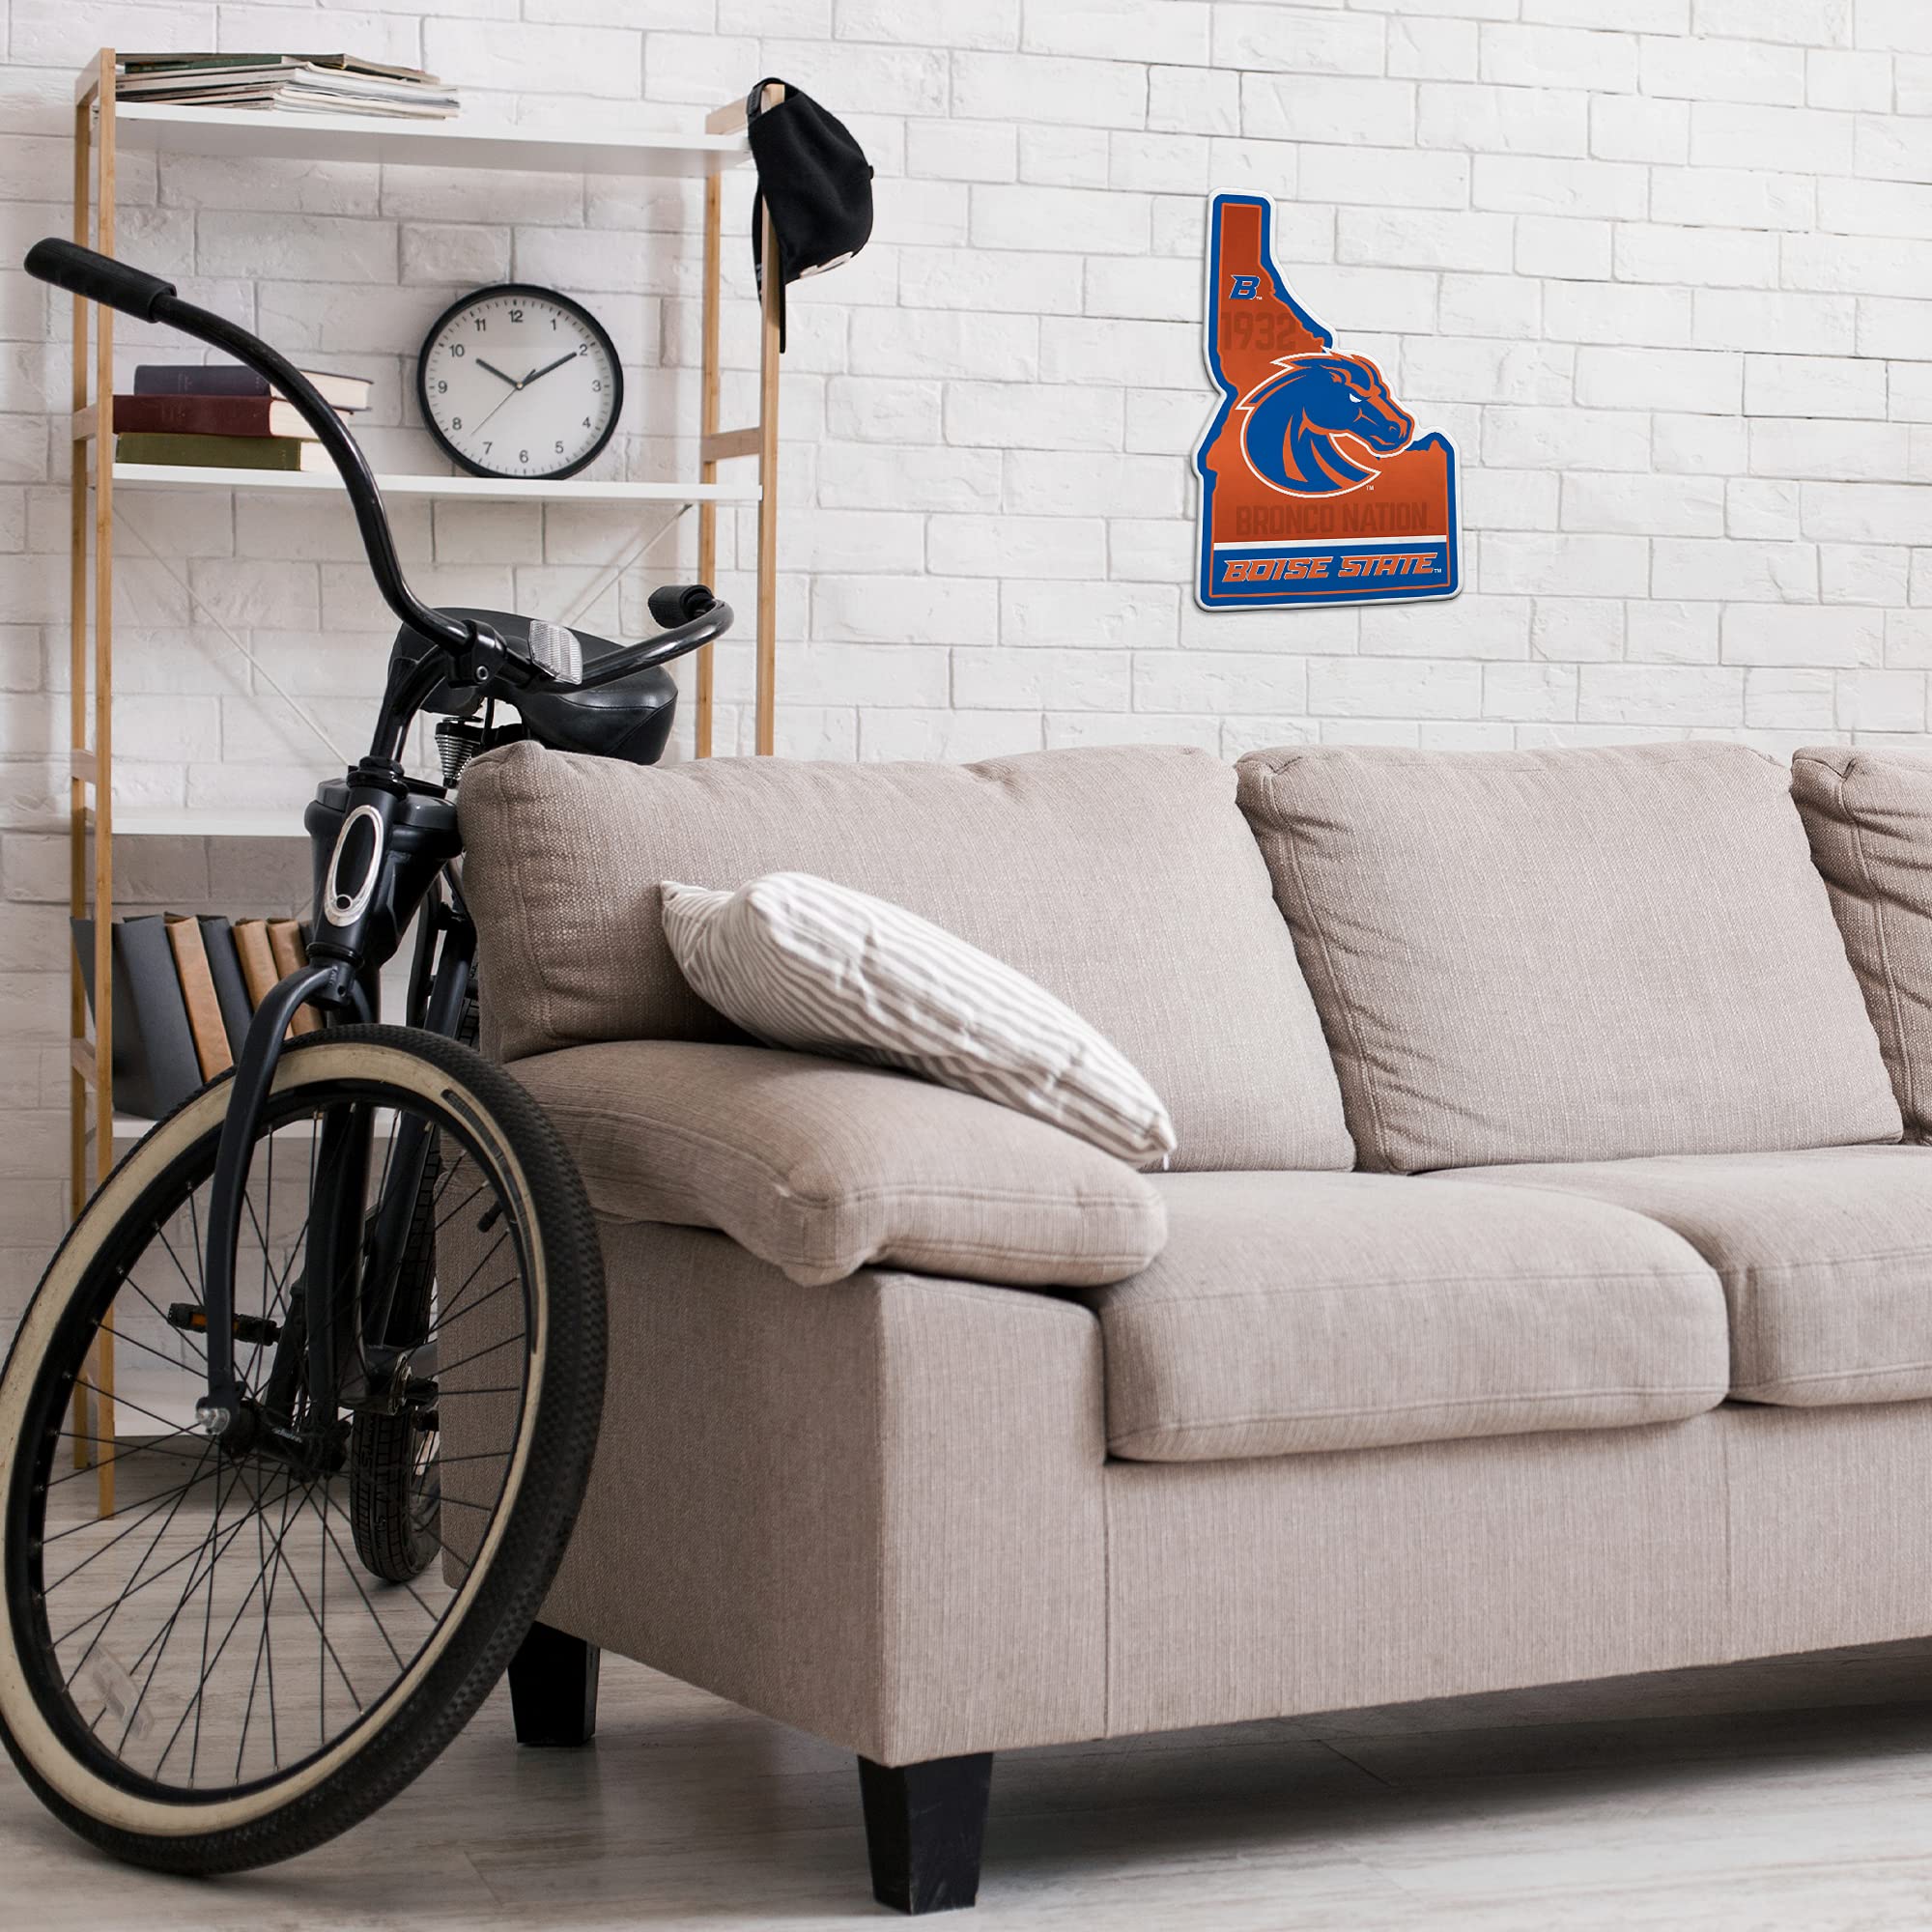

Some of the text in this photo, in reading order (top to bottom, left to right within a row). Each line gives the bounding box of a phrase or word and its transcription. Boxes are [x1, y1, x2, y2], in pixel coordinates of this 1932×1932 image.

[1229, 274, 1261, 300] B
[508, 309, 524, 324] 12
[474, 318, 487, 331] 11
[550, 318, 557, 330] 1
[1221, 311, 1296, 351] 1932
[449, 343, 466, 357] 10
[579, 343, 588, 356] 2
[438, 380, 448, 394] 9
[591, 379, 602, 392] 3
[451, 416, 463, 431] 8
[582, 416, 591, 429] 4
[482, 440, 494, 455] 7
[554, 440, 564, 454] 5
[519, 450, 529, 464] 6
[1236, 501, 1428, 536] BRONCO NATION
[1222, 556, 1334, 582] BOISE
[1338, 552, 1438, 578] STATE
